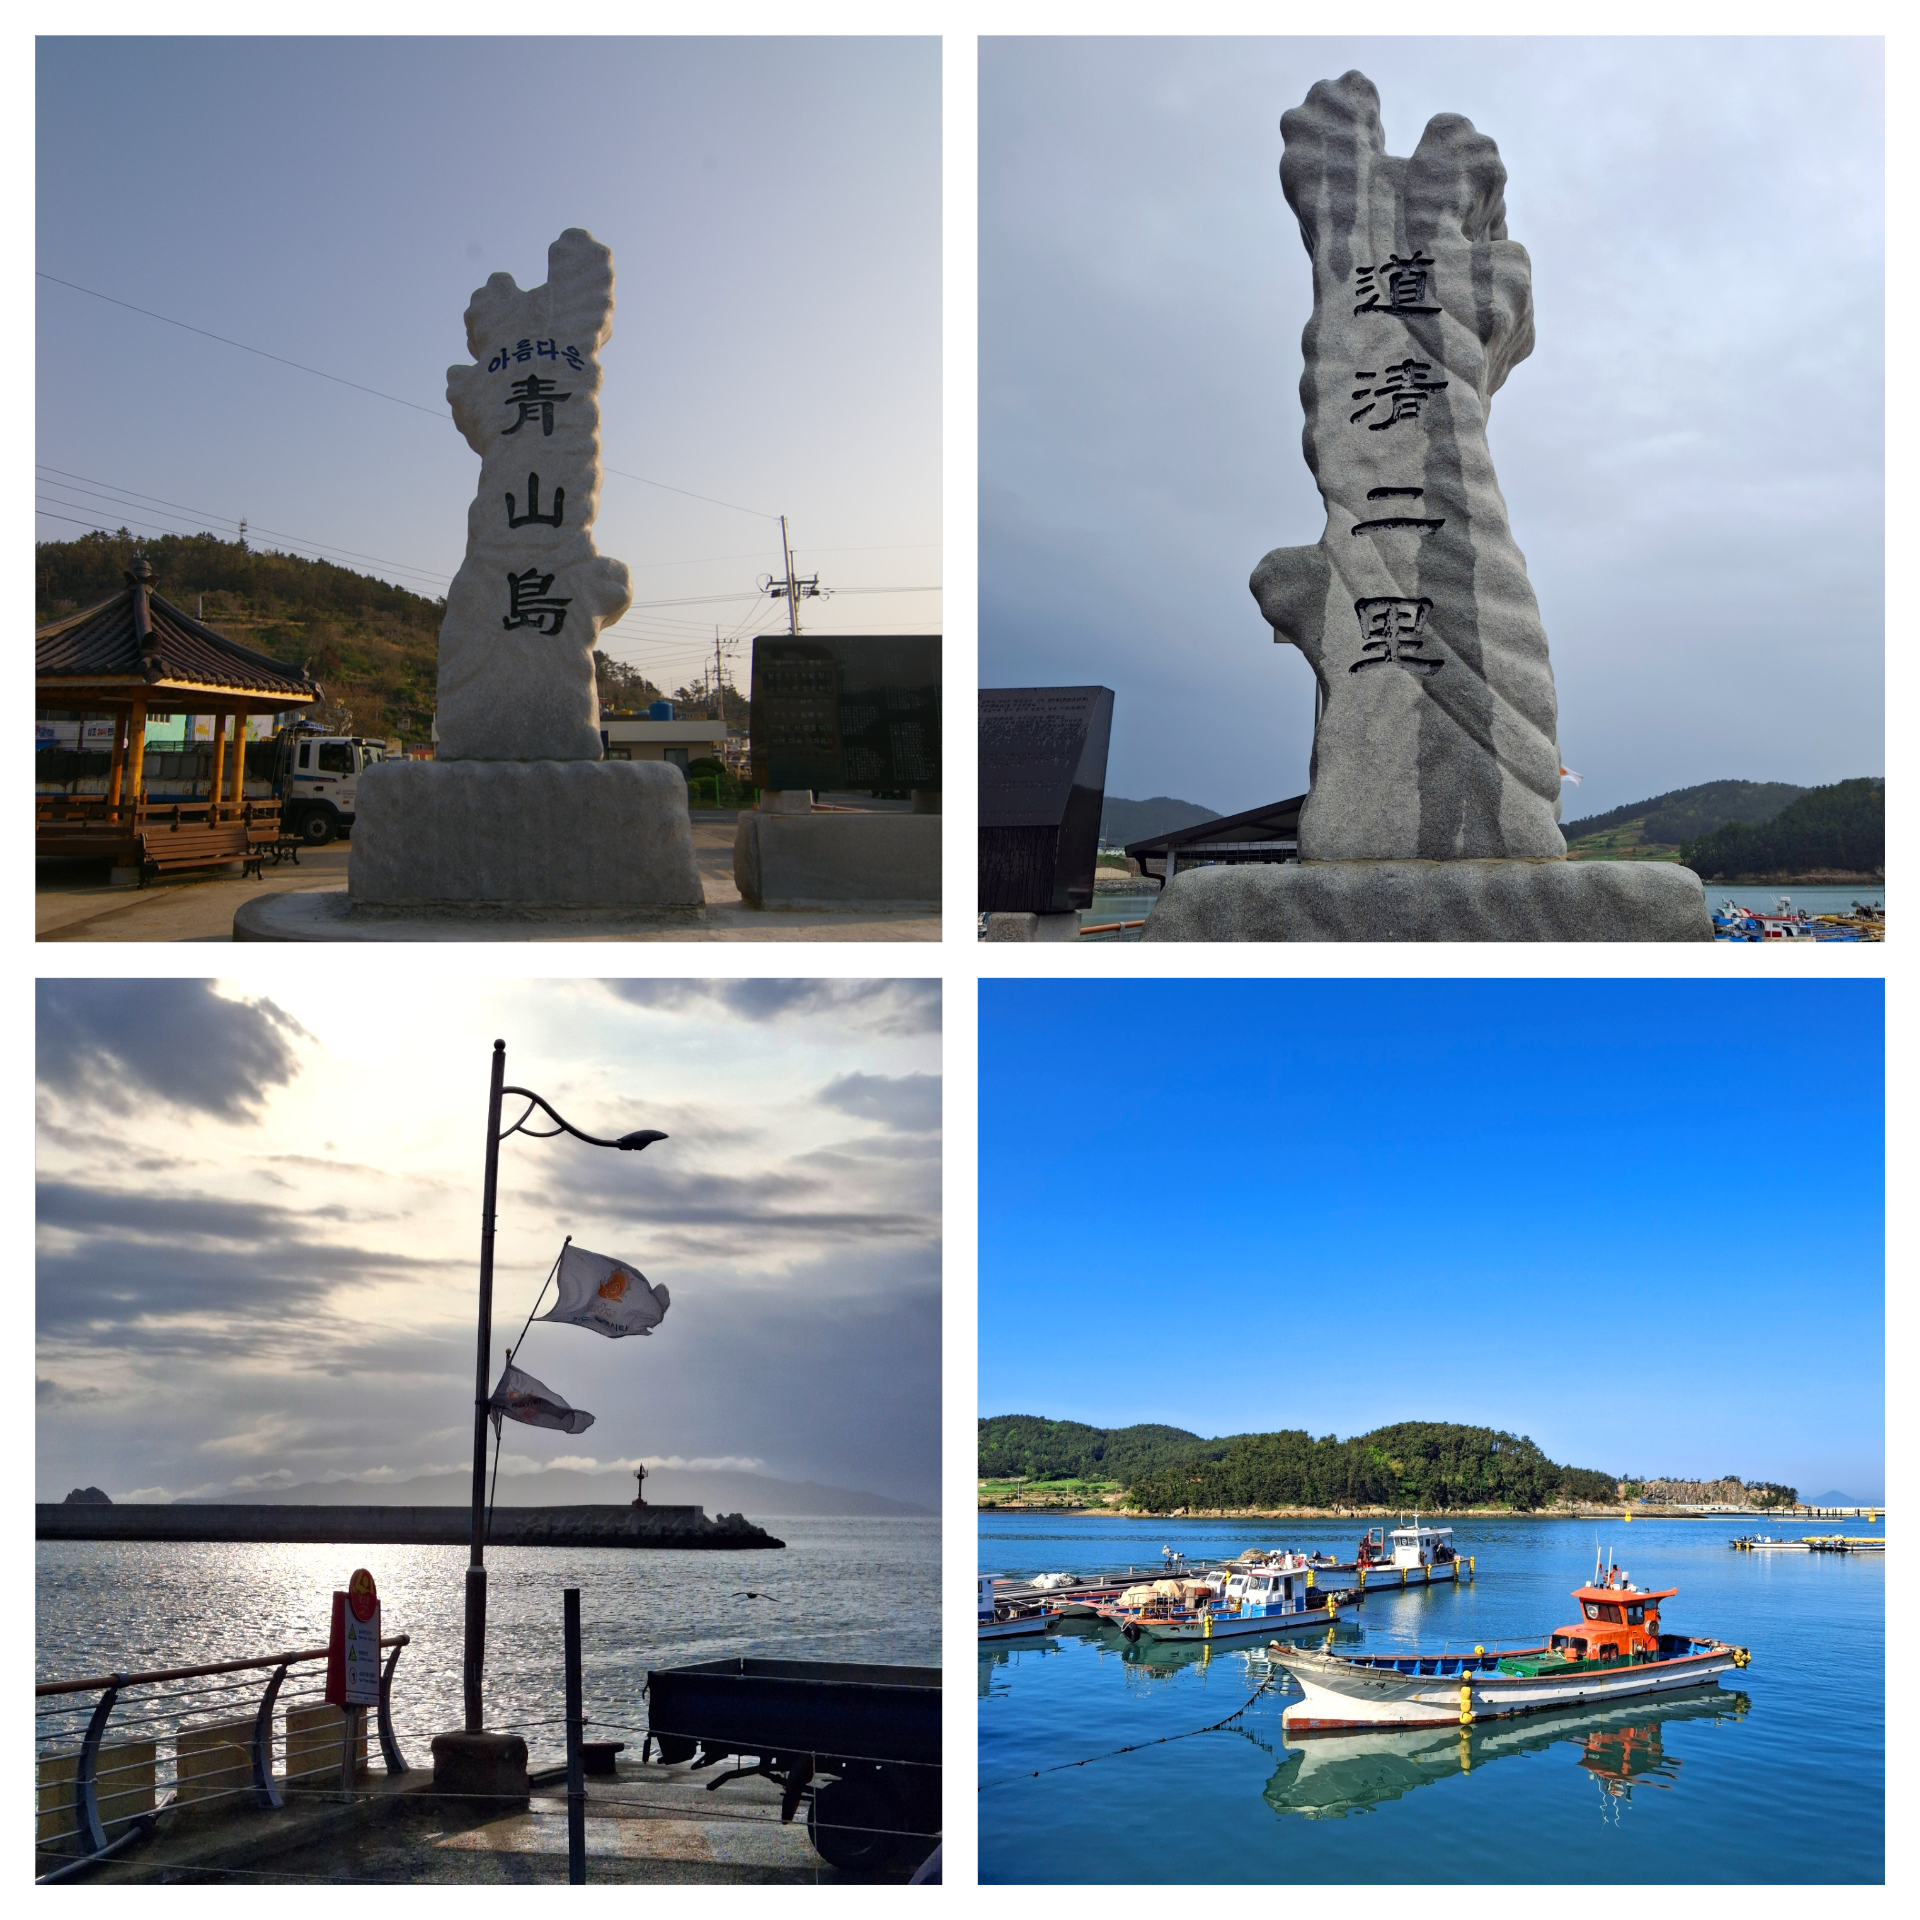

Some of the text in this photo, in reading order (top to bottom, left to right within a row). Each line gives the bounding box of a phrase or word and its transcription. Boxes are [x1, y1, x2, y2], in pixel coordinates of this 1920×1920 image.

[488, 338, 586, 373] 아름다운
[501, 374, 574, 636] 青山島
